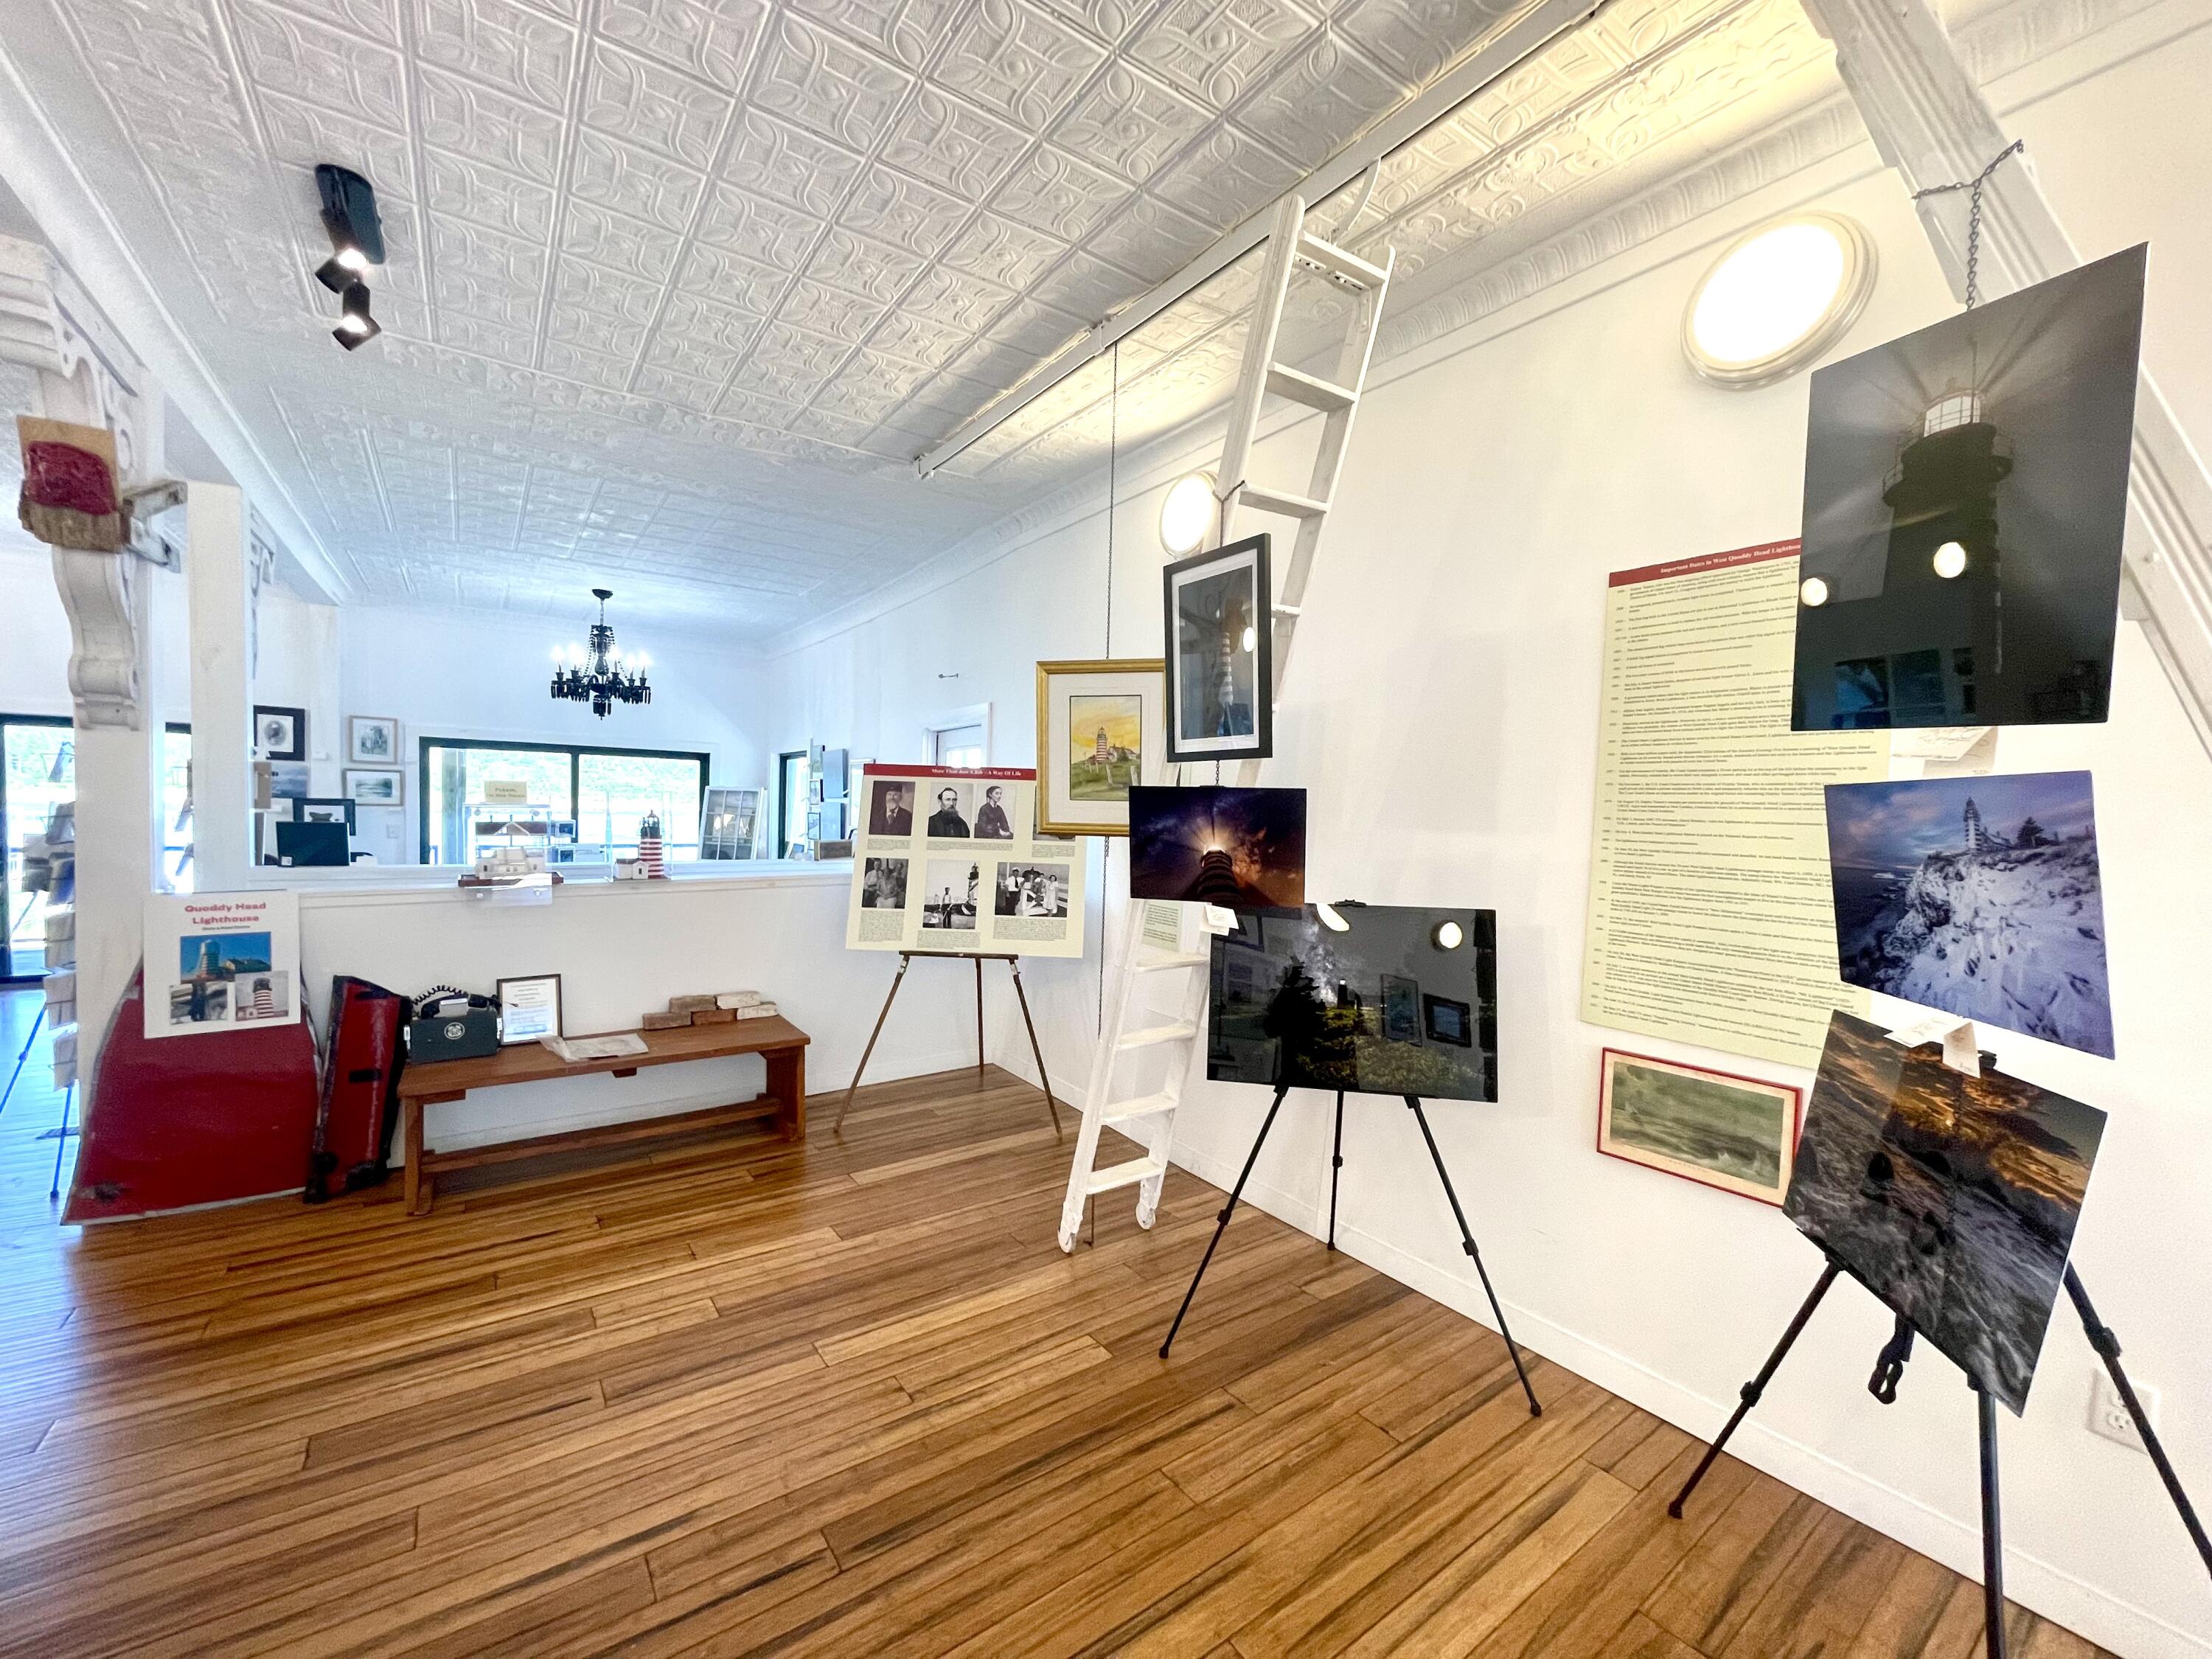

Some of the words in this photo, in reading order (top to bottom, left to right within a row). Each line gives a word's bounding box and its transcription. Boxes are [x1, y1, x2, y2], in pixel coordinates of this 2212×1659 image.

[1660, 564, 1688, 574] Important
[1728, 552, 1752, 561] Quoddy
[1771, 544, 1801, 554] Lighthou
[184, 904, 232, 913] Quoddy
[236, 902, 266, 911] Head
[192, 915, 260, 925] Lighthouse
